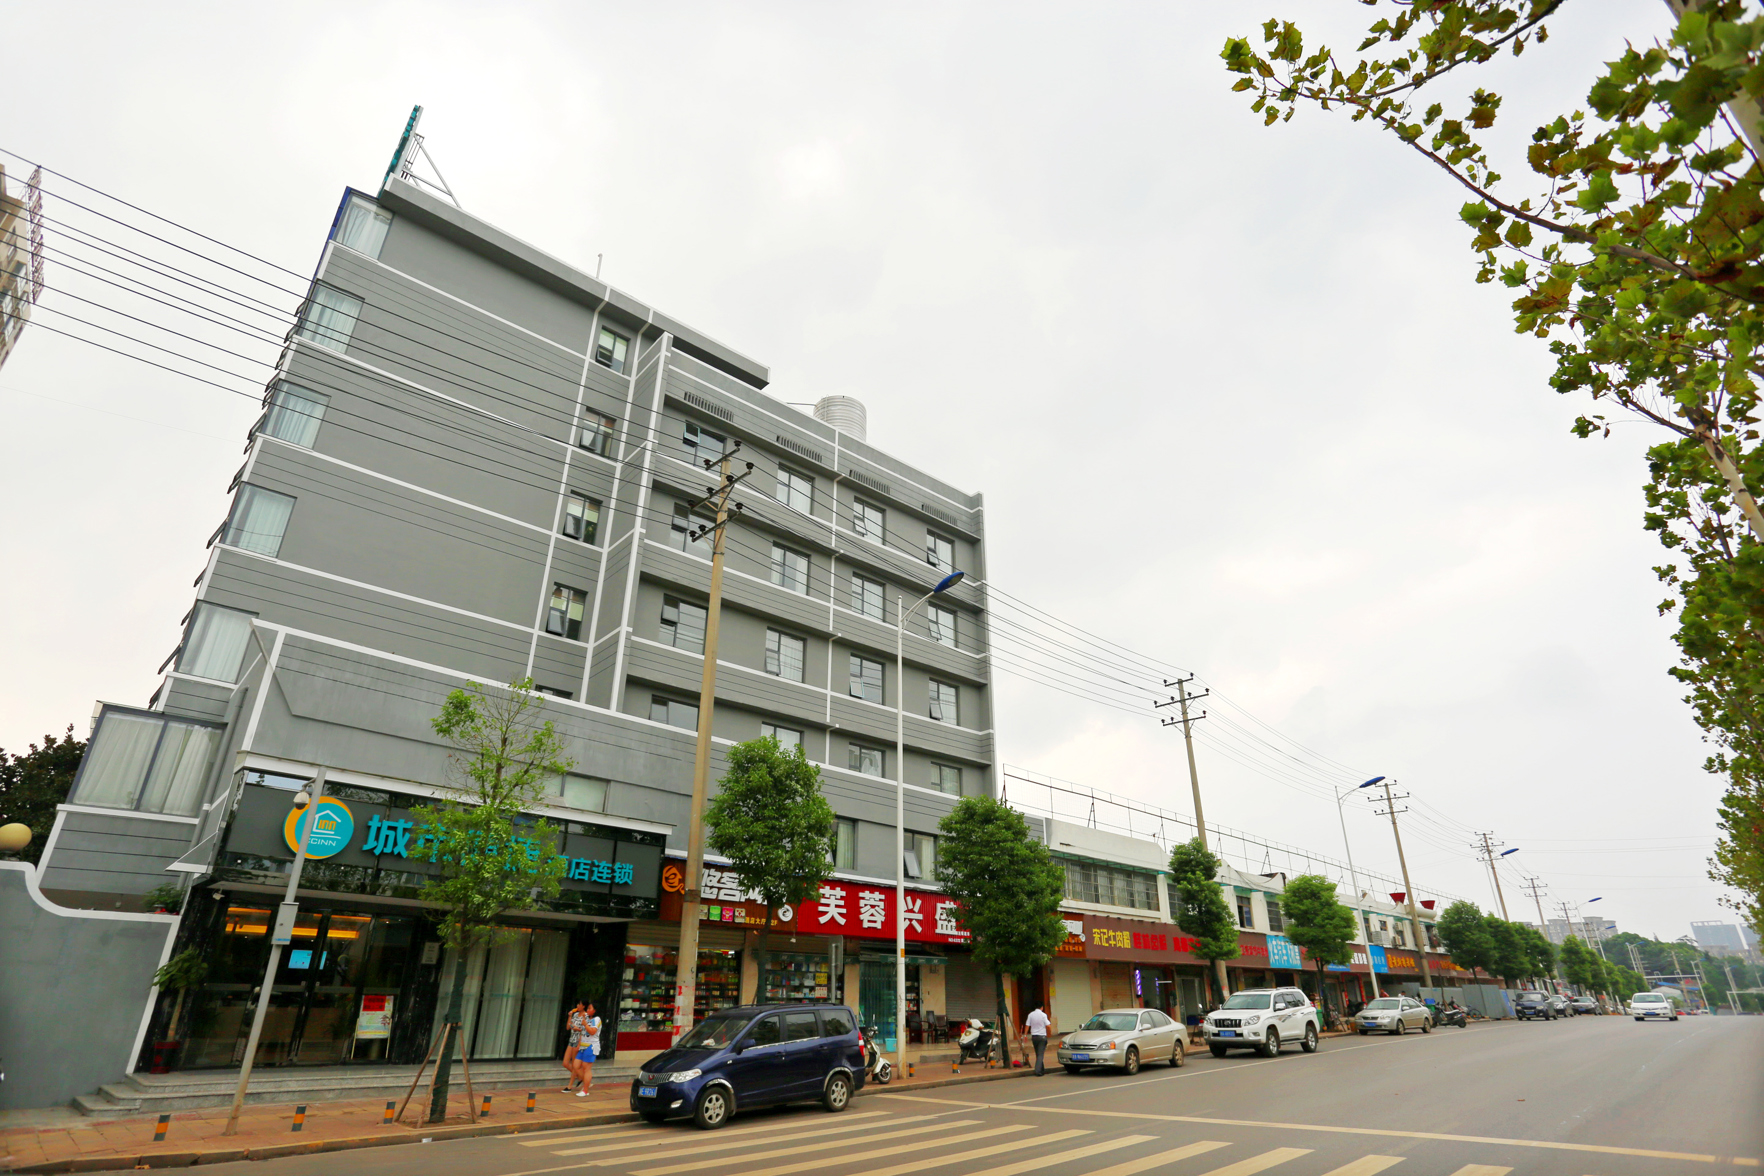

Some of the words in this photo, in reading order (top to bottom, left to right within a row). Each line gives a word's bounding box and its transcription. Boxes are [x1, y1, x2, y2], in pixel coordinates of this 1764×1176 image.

[307, 838, 337, 846] CINN
[818, 885, 957, 936] 芙蓉兴盛
